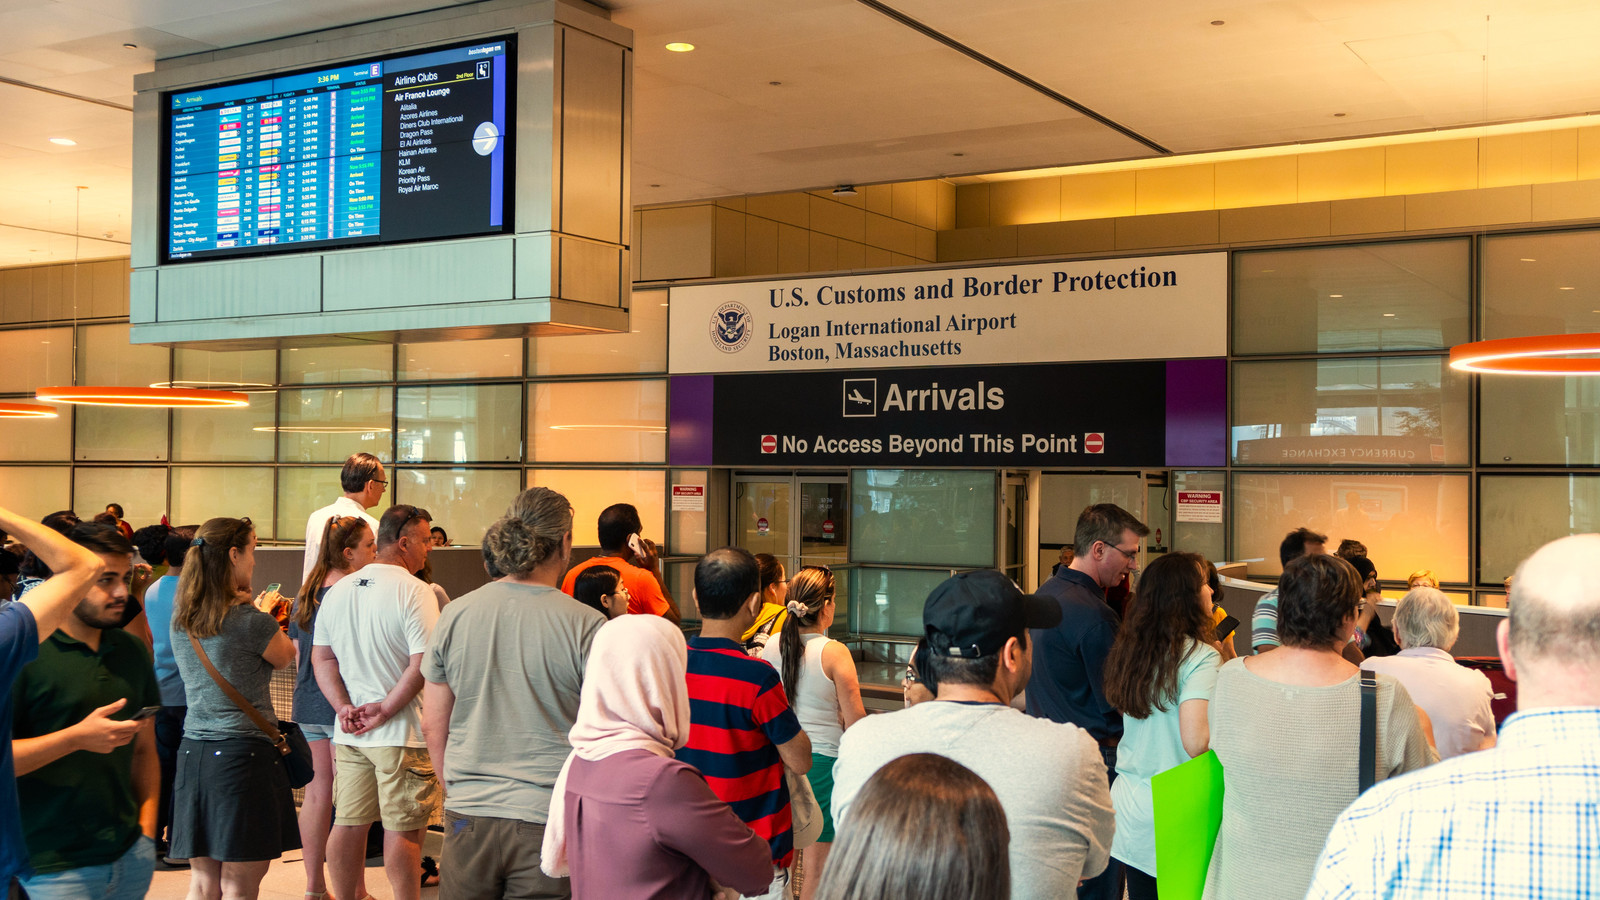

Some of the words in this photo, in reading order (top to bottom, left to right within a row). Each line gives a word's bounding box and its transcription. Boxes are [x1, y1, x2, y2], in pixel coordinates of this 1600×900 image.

[372, 66, 377, 74] E
[395, 75, 416, 86] Airline
[418, 72, 437, 82] Clubs
[405, 91, 425, 100] France
[427, 88, 450, 96] Lounge
[431, 115, 463, 125] International
[400, 131, 419, 139] Dragon
[398, 186, 413, 194] Royal
[769, 287, 809, 308] U.S.
[816, 285, 906, 307] Customs
[914, 279, 953, 300] and
[963, 275, 1042, 298] Border
[1052, 266, 1177, 293] Protection
[719, 304, 748, 316] DEPARTMENT
[769, 323, 820, 343] Logan
[826, 315, 940, 337] International
[946, 313, 1017, 335] Airport
[712, 331, 731, 351] HOMELAND
[733, 330, 750, 350] SECURITY
[768, 345, 829, 363] Boston,
[835, 340, 961, 360] Massachusetts
[883, 381, 1004, 412] Arrivals
[783, 435, 808, 453] No
[813, 435, 882, 453] Access
[889, 434, 963, 457] Beyond
[970, 434, 1014, 453] This
[1021, 433, 1077, 453] Point
